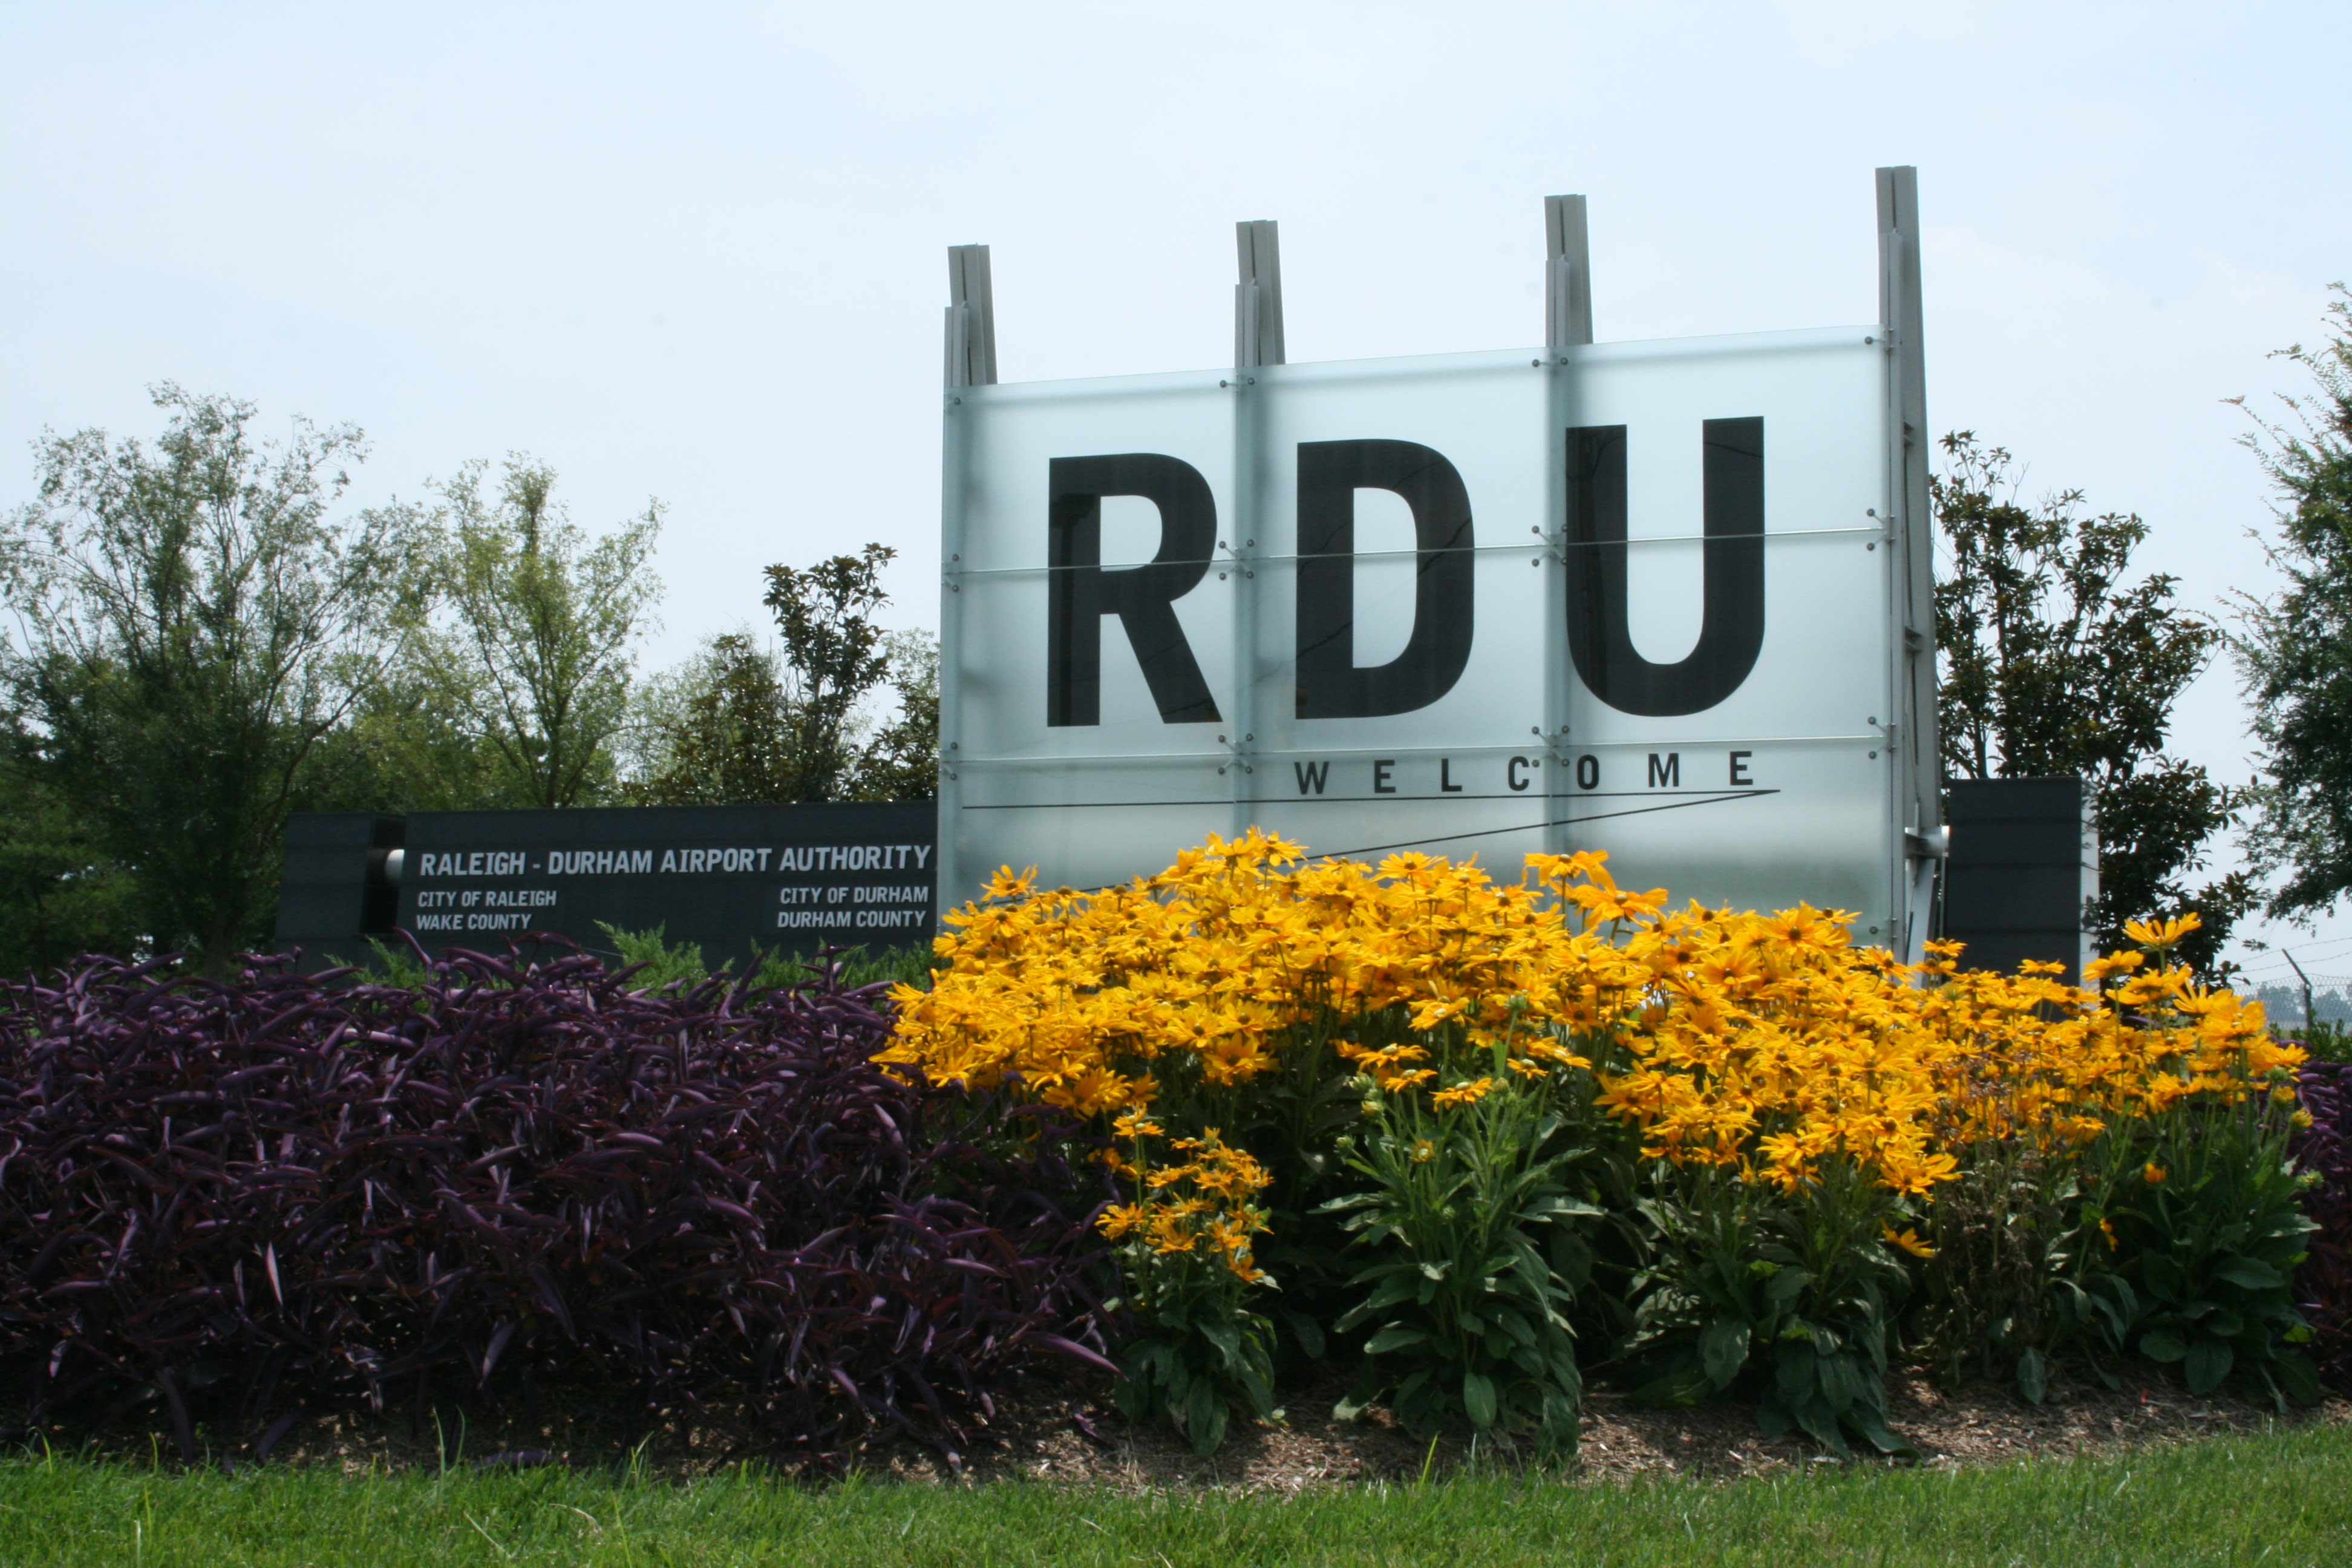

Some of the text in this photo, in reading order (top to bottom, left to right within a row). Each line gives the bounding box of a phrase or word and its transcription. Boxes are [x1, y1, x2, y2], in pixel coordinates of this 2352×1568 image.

[1047, 415, 1765, 727] RDU
[1295, 751, 1754, 795] WELCOME
[420, 852, 526, 876] RALEIGH
[547, 850, 653, 875] DURHAM
[658, 848, 773, 873] AIRPORT
[779, 845, 932, 871] AUTHORITY
[417, 890, 557, 907] CITY OF RALEIGH
[780, 886, 929, 904] CITY OF DURHAM
[416, 913, 532, 930] WAKE COUNTY
[777, 910, 926, 928] DURHAM COUNTY
